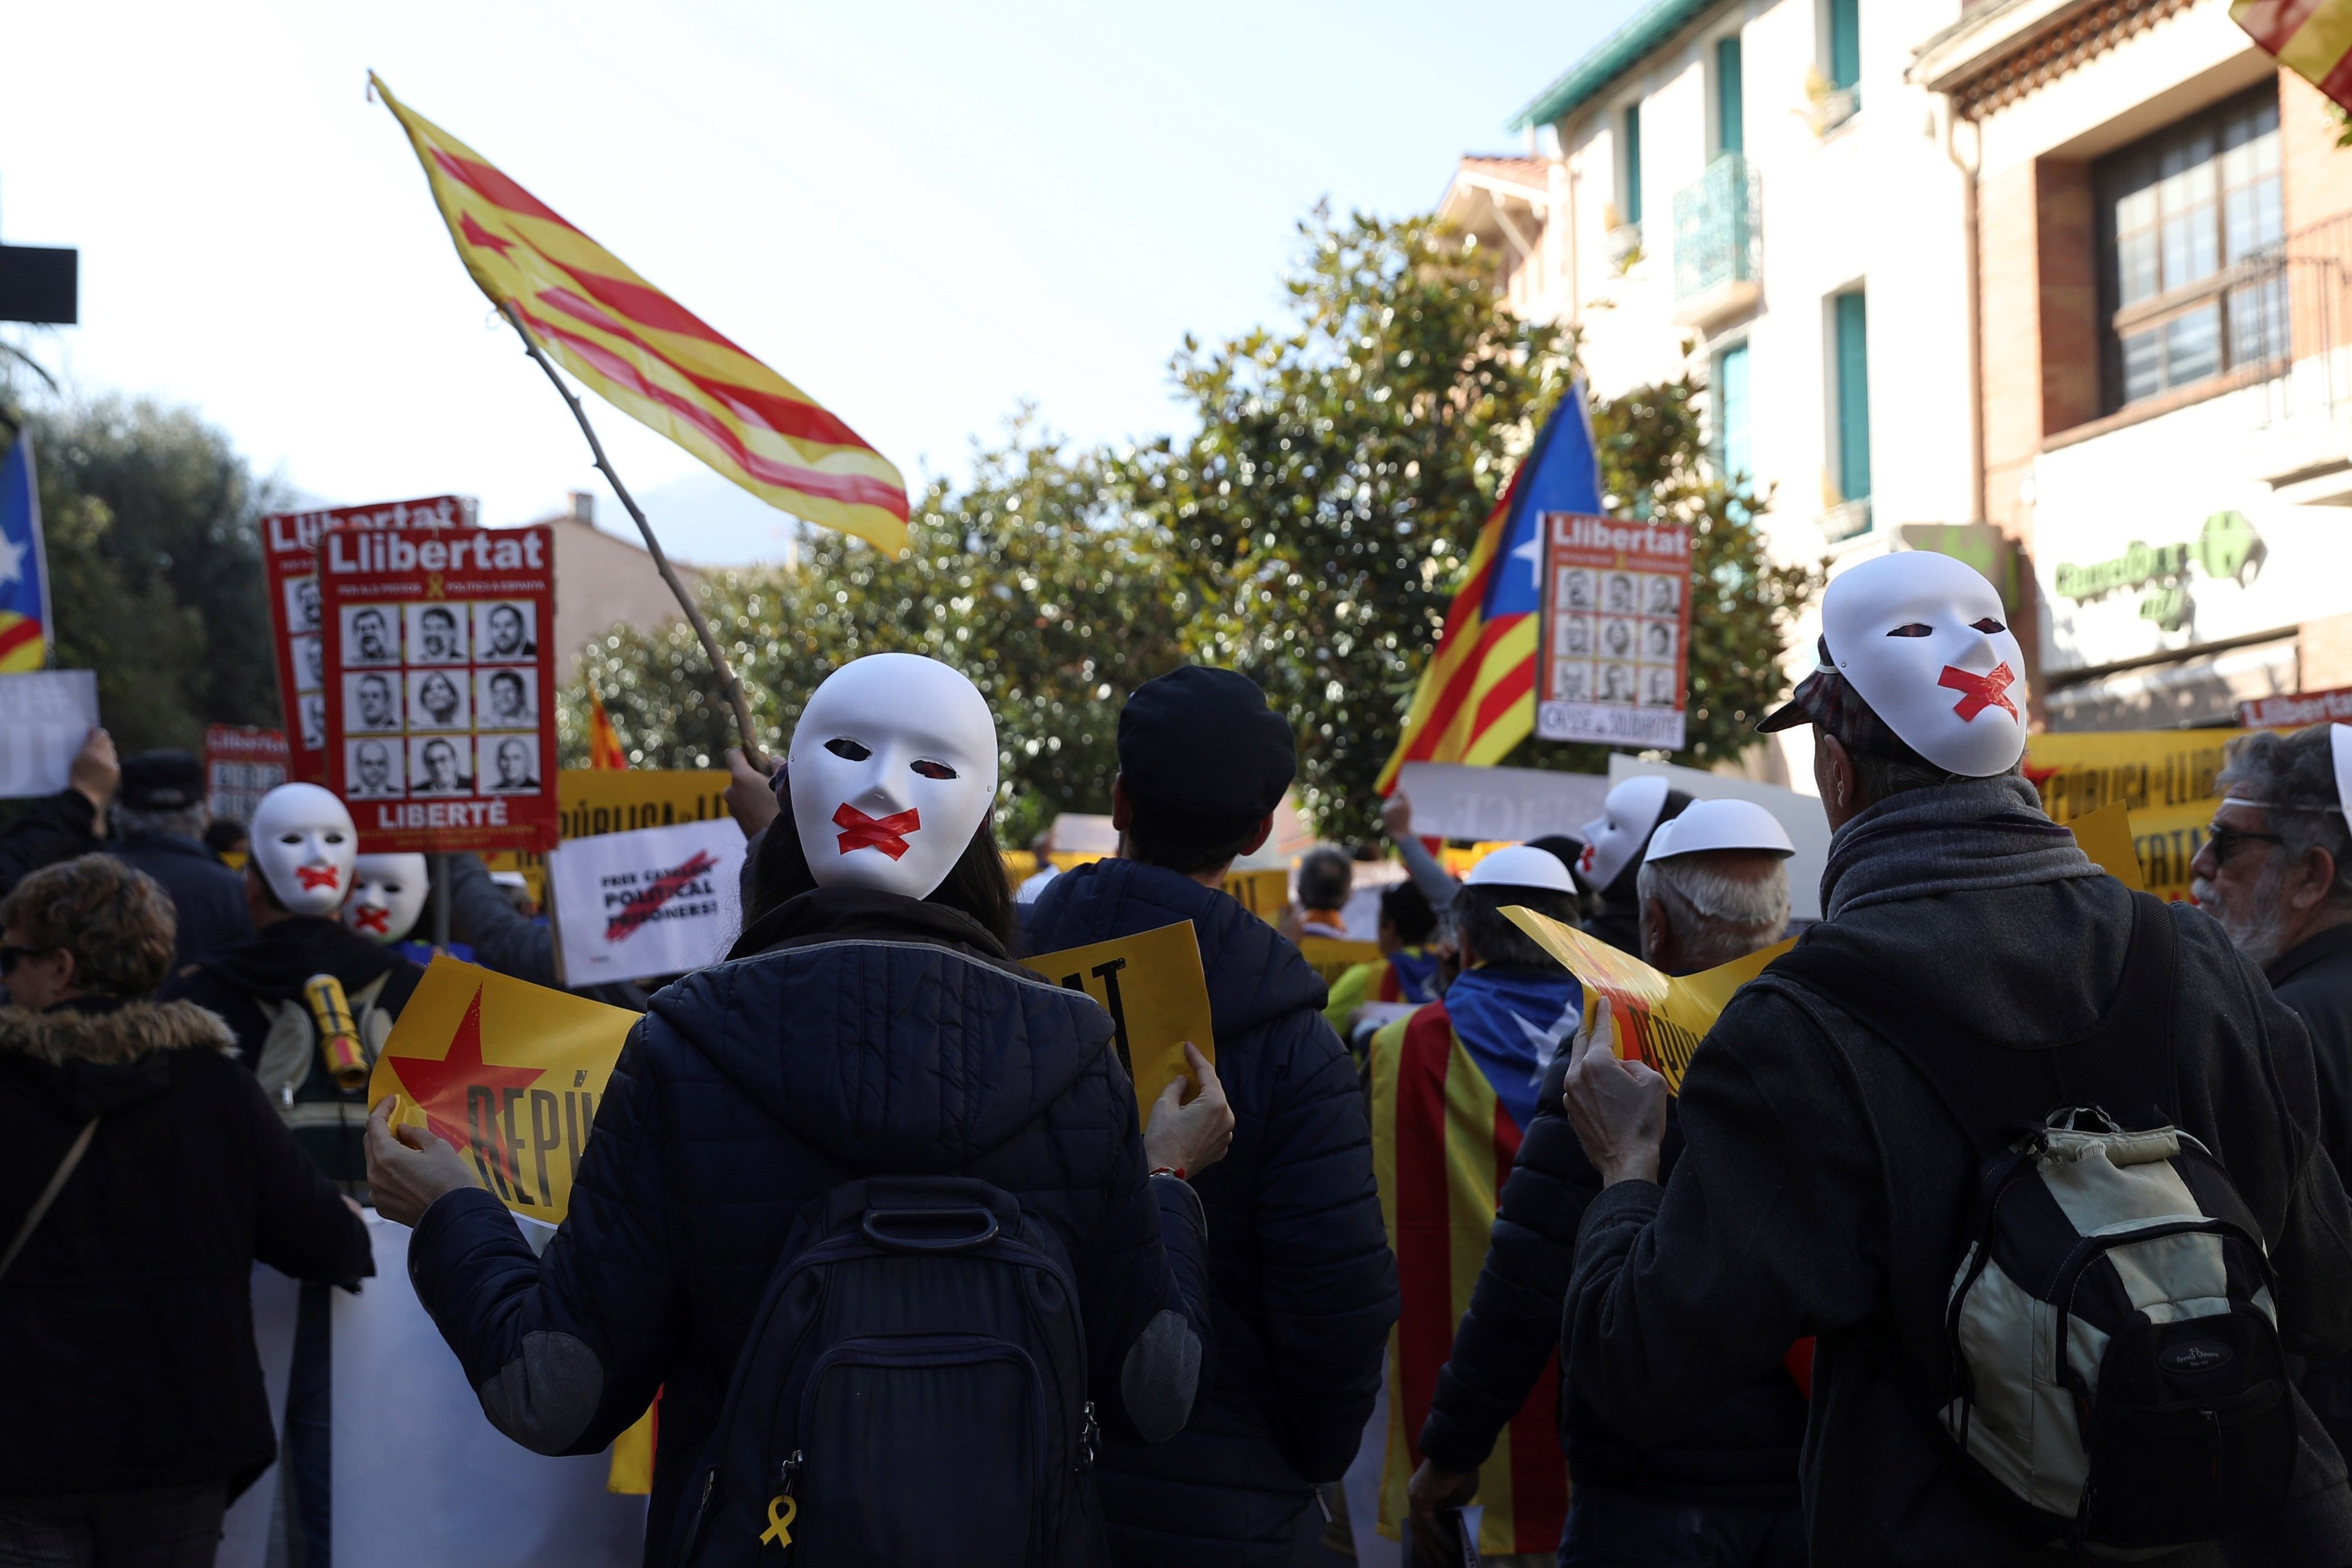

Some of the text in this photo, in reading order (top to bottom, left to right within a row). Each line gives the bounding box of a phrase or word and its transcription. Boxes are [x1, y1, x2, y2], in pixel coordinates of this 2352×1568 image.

[330, 531, 544, 574] Llibertat
[1553, 515, 1688, 557] Llibertat
[378, 796, 508, 829] LIBERTÉ
[602, 874, 636, 887] FREE
[467, 1070, 603, 1207] REPÚ
